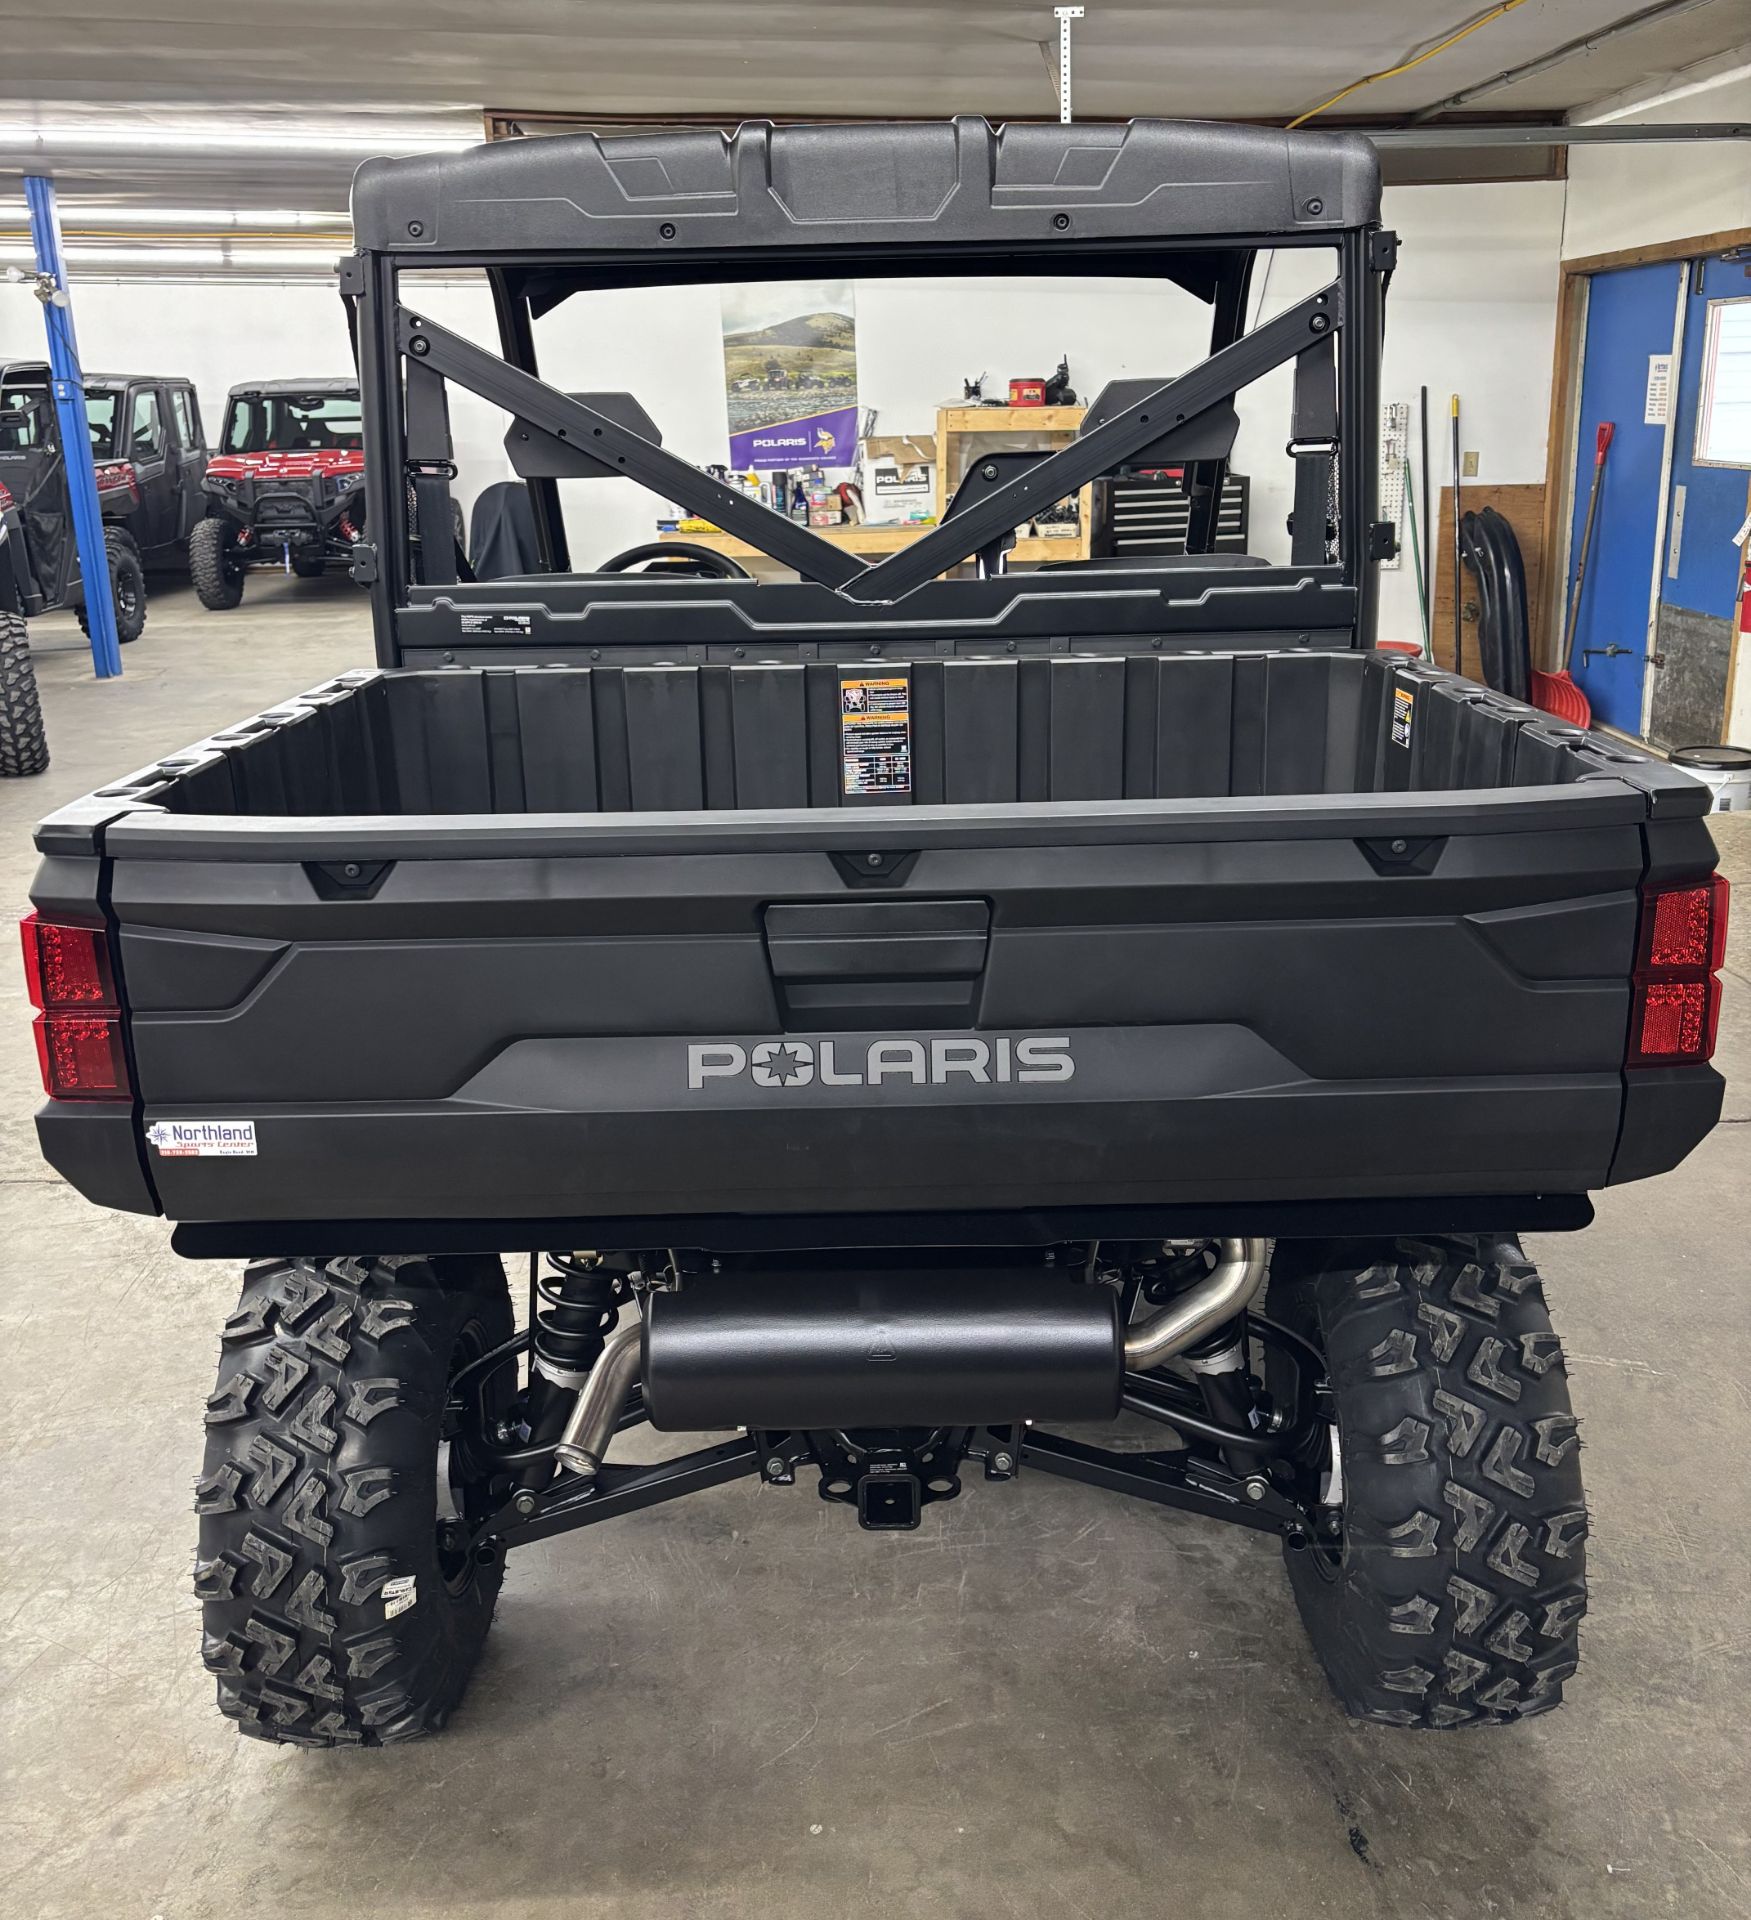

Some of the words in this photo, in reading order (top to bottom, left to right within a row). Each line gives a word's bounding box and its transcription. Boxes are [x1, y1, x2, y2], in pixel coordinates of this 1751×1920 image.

[752, 438, 807, 447] POLARIS
[876, 474, 928, 484] POLRIS
[686, 1036, 1076, 1090] POLARIS
[172, 1125, 253, 1140] Northland
